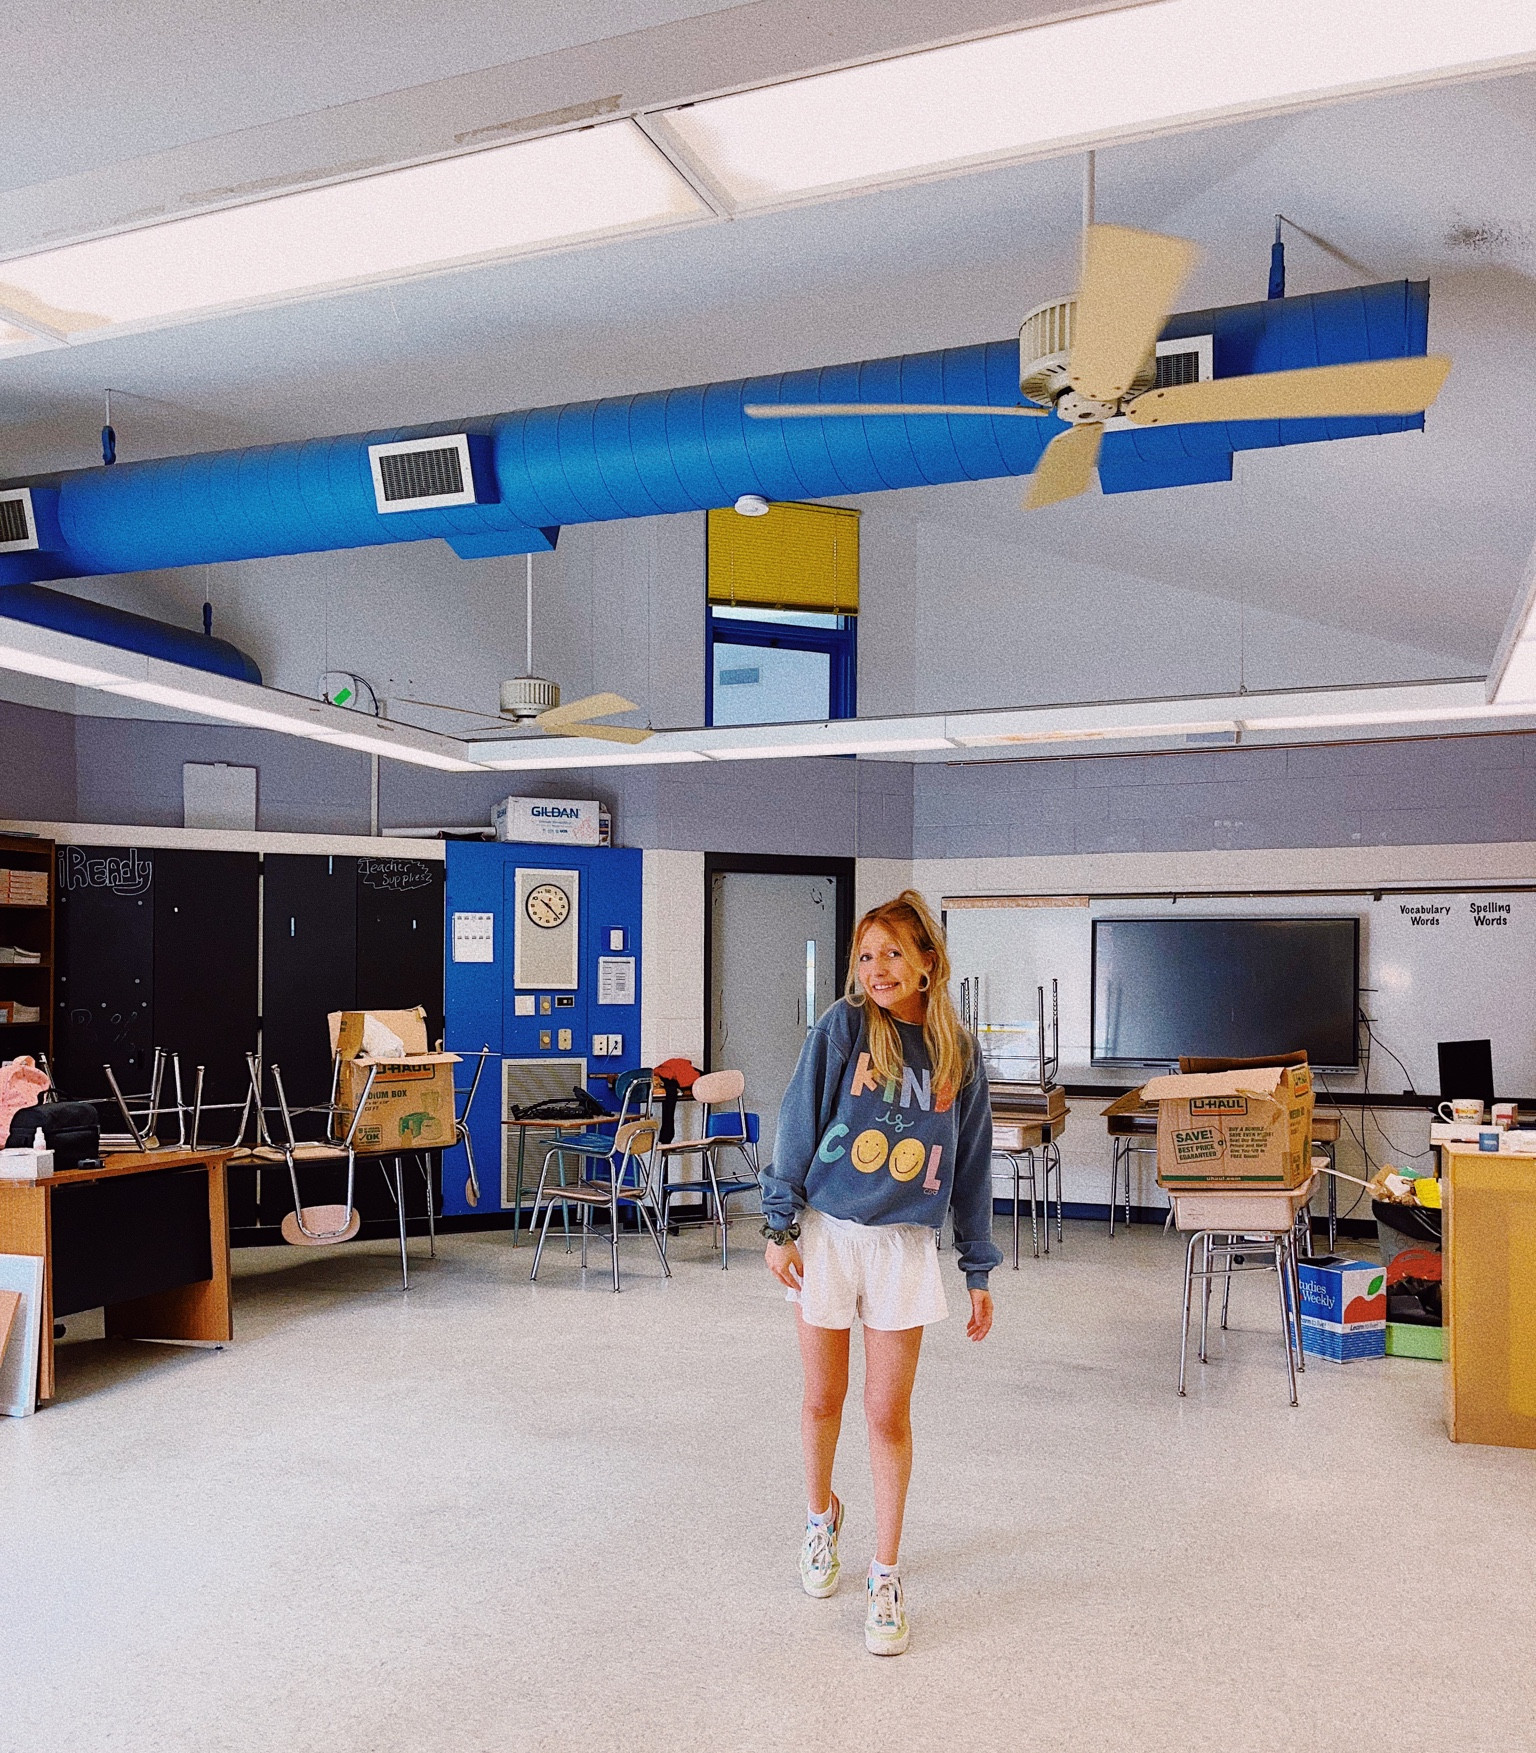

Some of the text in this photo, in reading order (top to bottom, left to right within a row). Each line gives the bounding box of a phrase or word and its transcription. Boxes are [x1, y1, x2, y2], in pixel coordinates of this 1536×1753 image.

[531, 806, 579, 819] GILDAN
[364, 859, 411, 874] Teacher
[382, 873, 426, 887] Supplies
[1400, 904, 1451, 915] Vocabulary
[1469, 902, 1511, 915] Spelling
[1411, 916, 1440, 926] Words
[1474, 915, 1507, 926] Words
[391, 1089, 407, 1098] BOX
[1193, 1100, 1244, 1109] U-HAUL
[875, 1106, 914, 1132] is
[1176, 1129, 1214, 1143] SAVE!
[1178, 1144, 1215, 1154] BEST PRICE
[818, 1123, 943, 1190] COOL
[1299, 1279, 1326, 1294] tudies
[1302, 1290, 1335, 1309] Weekly
